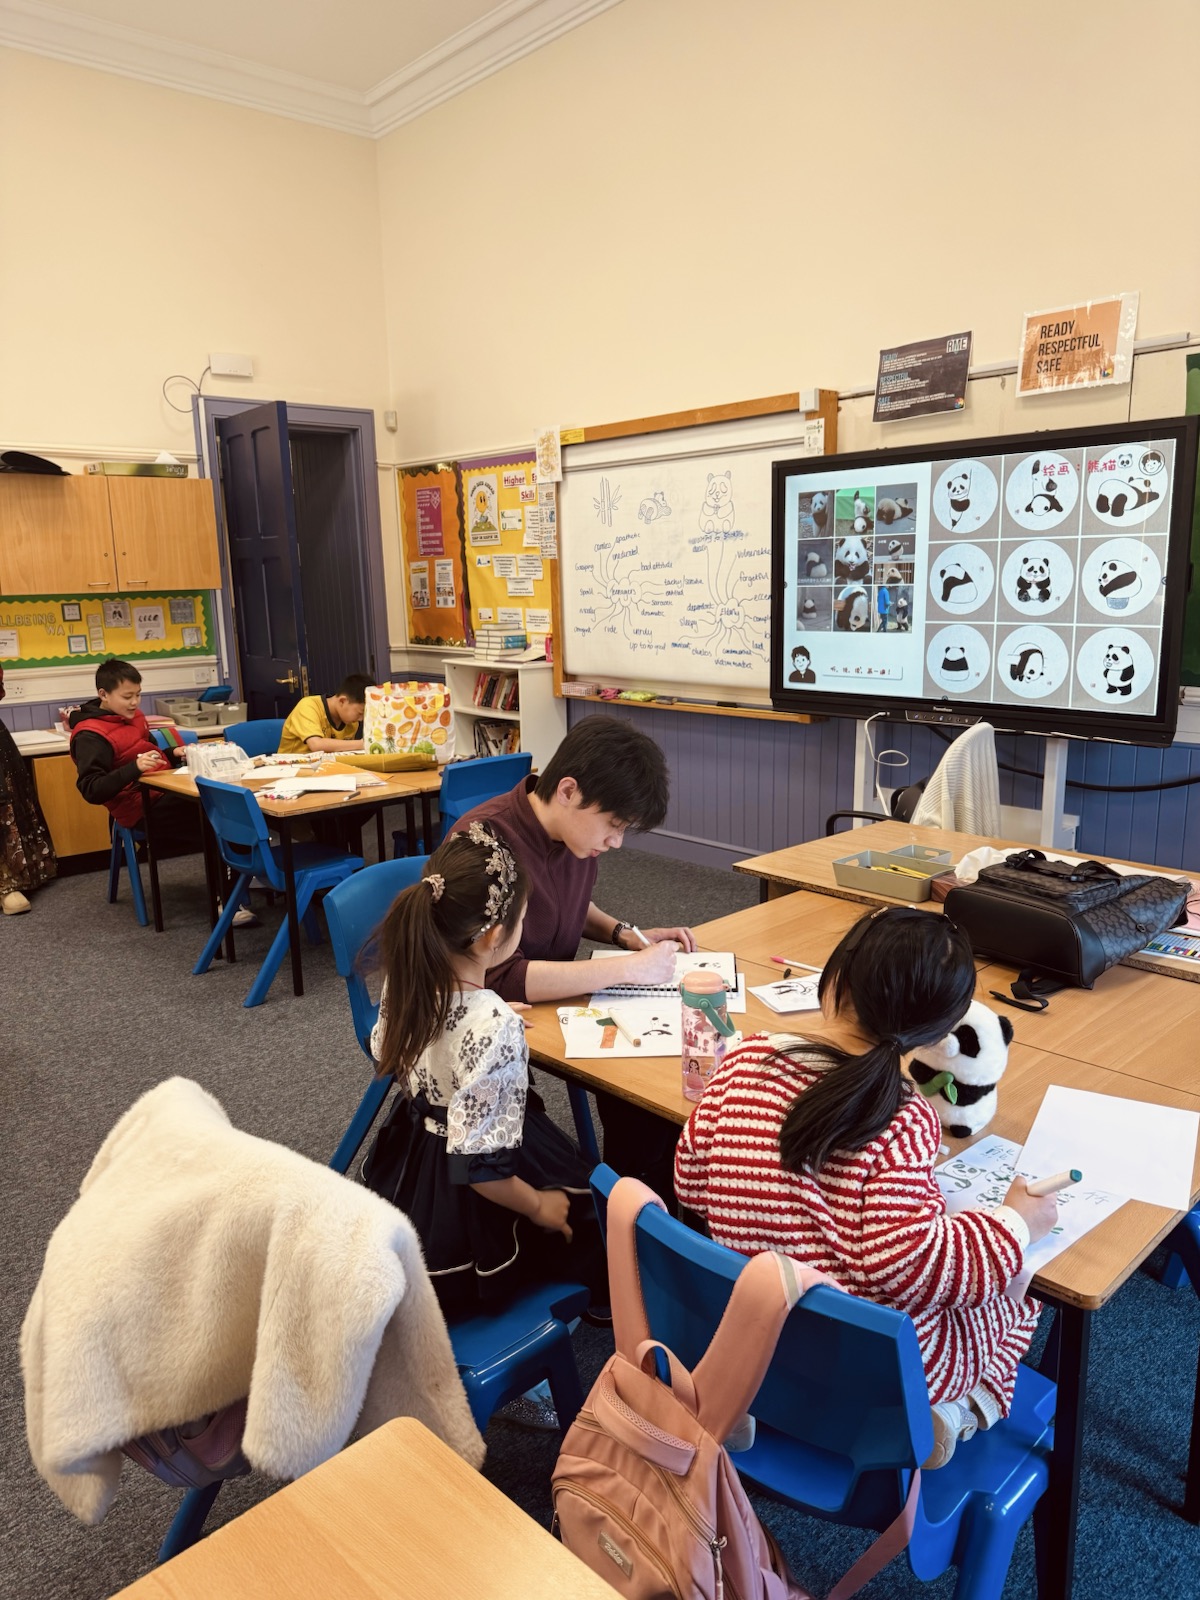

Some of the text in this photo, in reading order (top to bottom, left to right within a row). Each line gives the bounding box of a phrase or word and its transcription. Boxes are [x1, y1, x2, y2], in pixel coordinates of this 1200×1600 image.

[1040, 319, 1075, 339] READY
[1038, 333, 1101, 356] RESPECTFUL
[1036, 357, 1062, 374] SAFE
[503, 474, 525, 486] Higher
